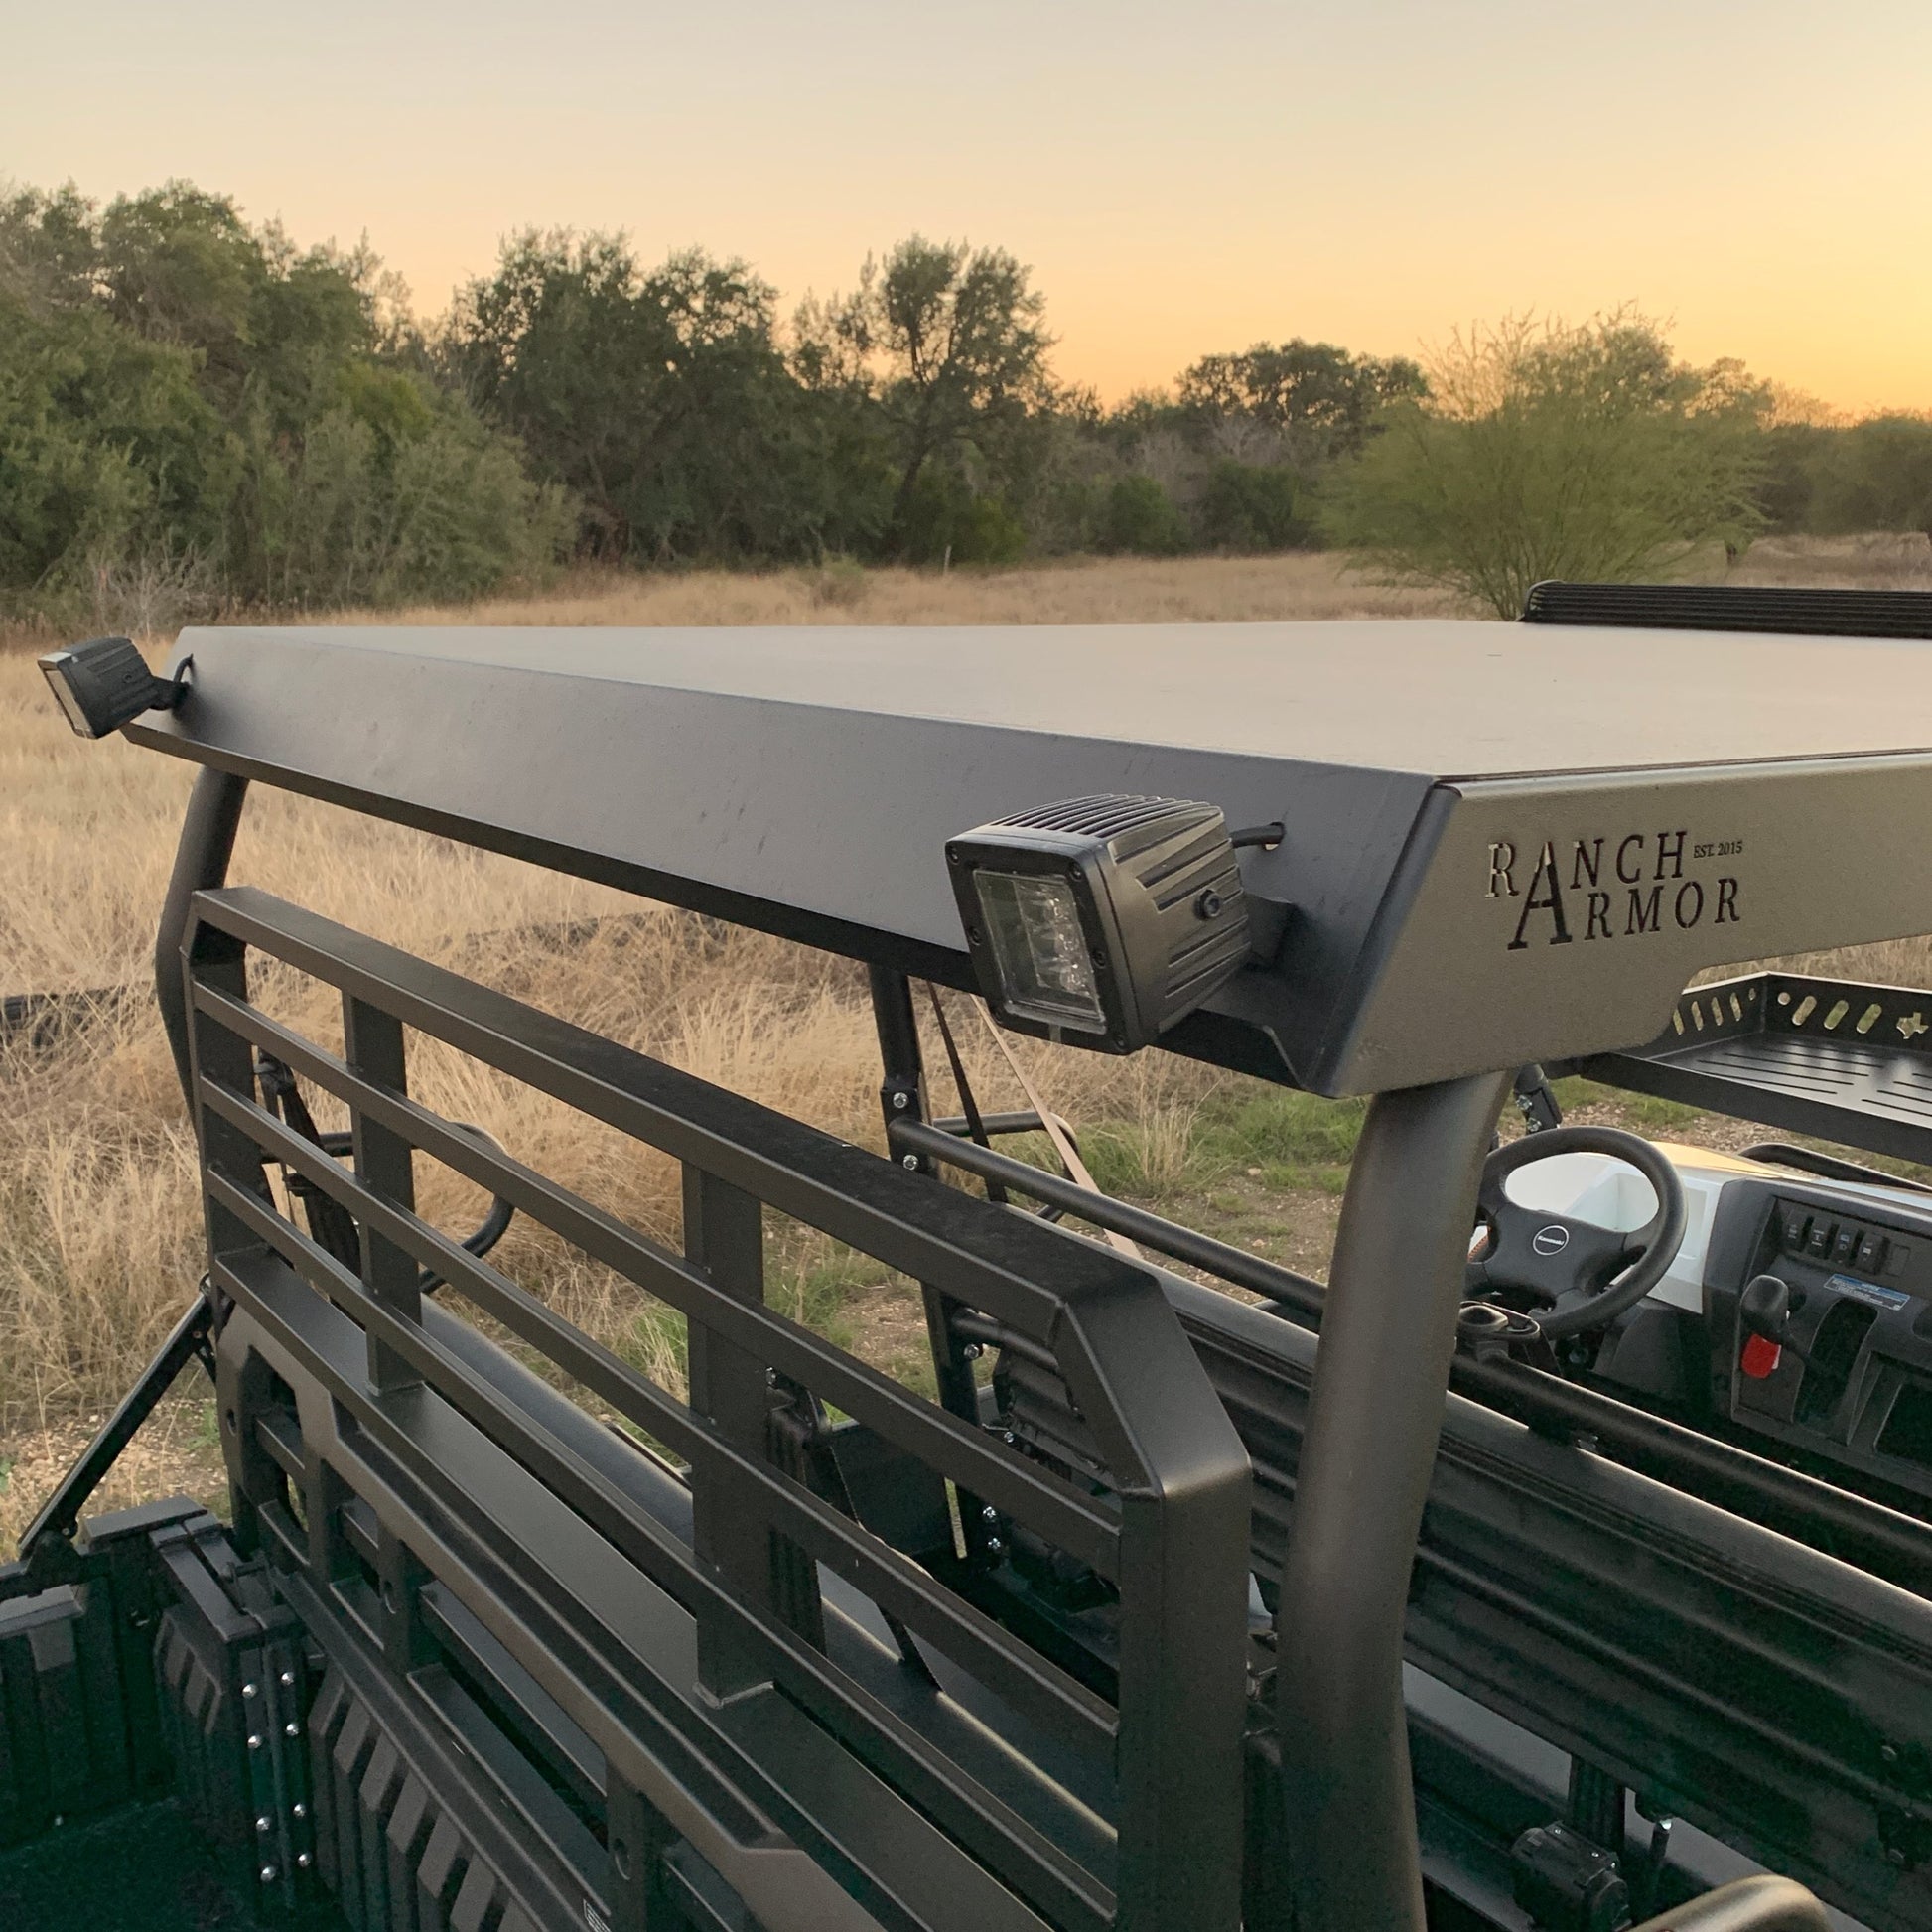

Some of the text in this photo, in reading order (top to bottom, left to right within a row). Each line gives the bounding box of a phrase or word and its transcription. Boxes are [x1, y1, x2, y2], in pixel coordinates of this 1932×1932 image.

[1485, 831, 1687, 918] RANCH
[1717, 840, 1743, 856] 2015
[1507, 842, 1740, 950] ARMOR
